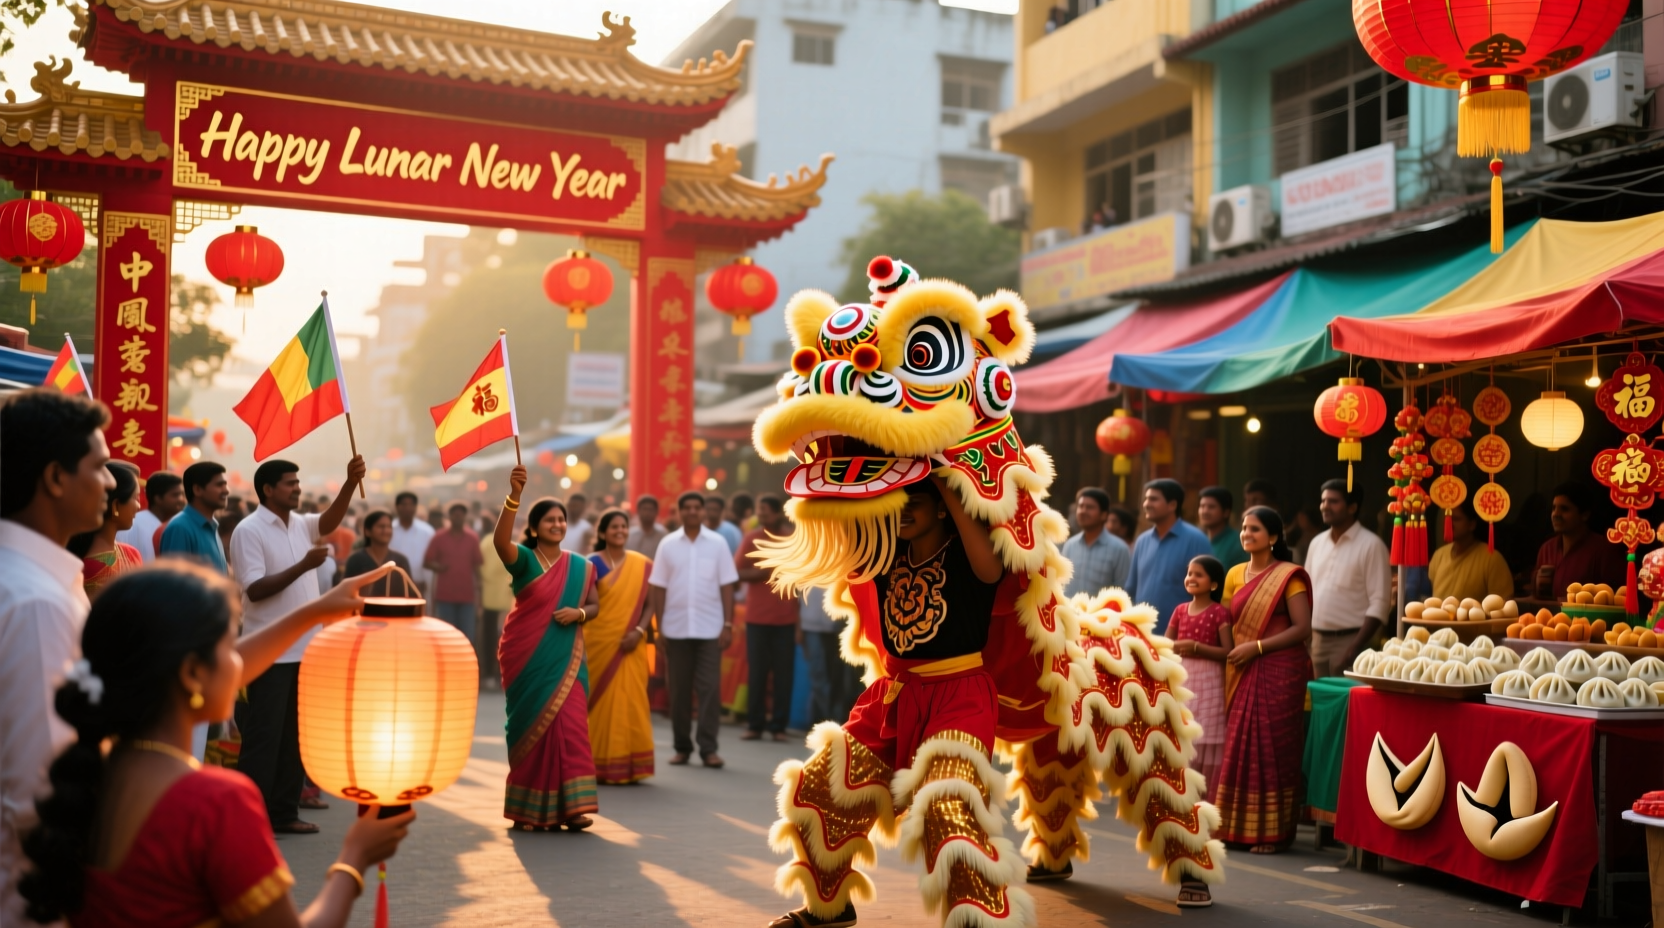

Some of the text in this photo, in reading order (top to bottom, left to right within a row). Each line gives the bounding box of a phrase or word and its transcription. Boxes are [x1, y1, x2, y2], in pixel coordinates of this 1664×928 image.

[199, 110, 627, 200] Happy Lunar New Year
[471, 382, 499, 416] 福
[1613, 373, 1656, 419] 福
